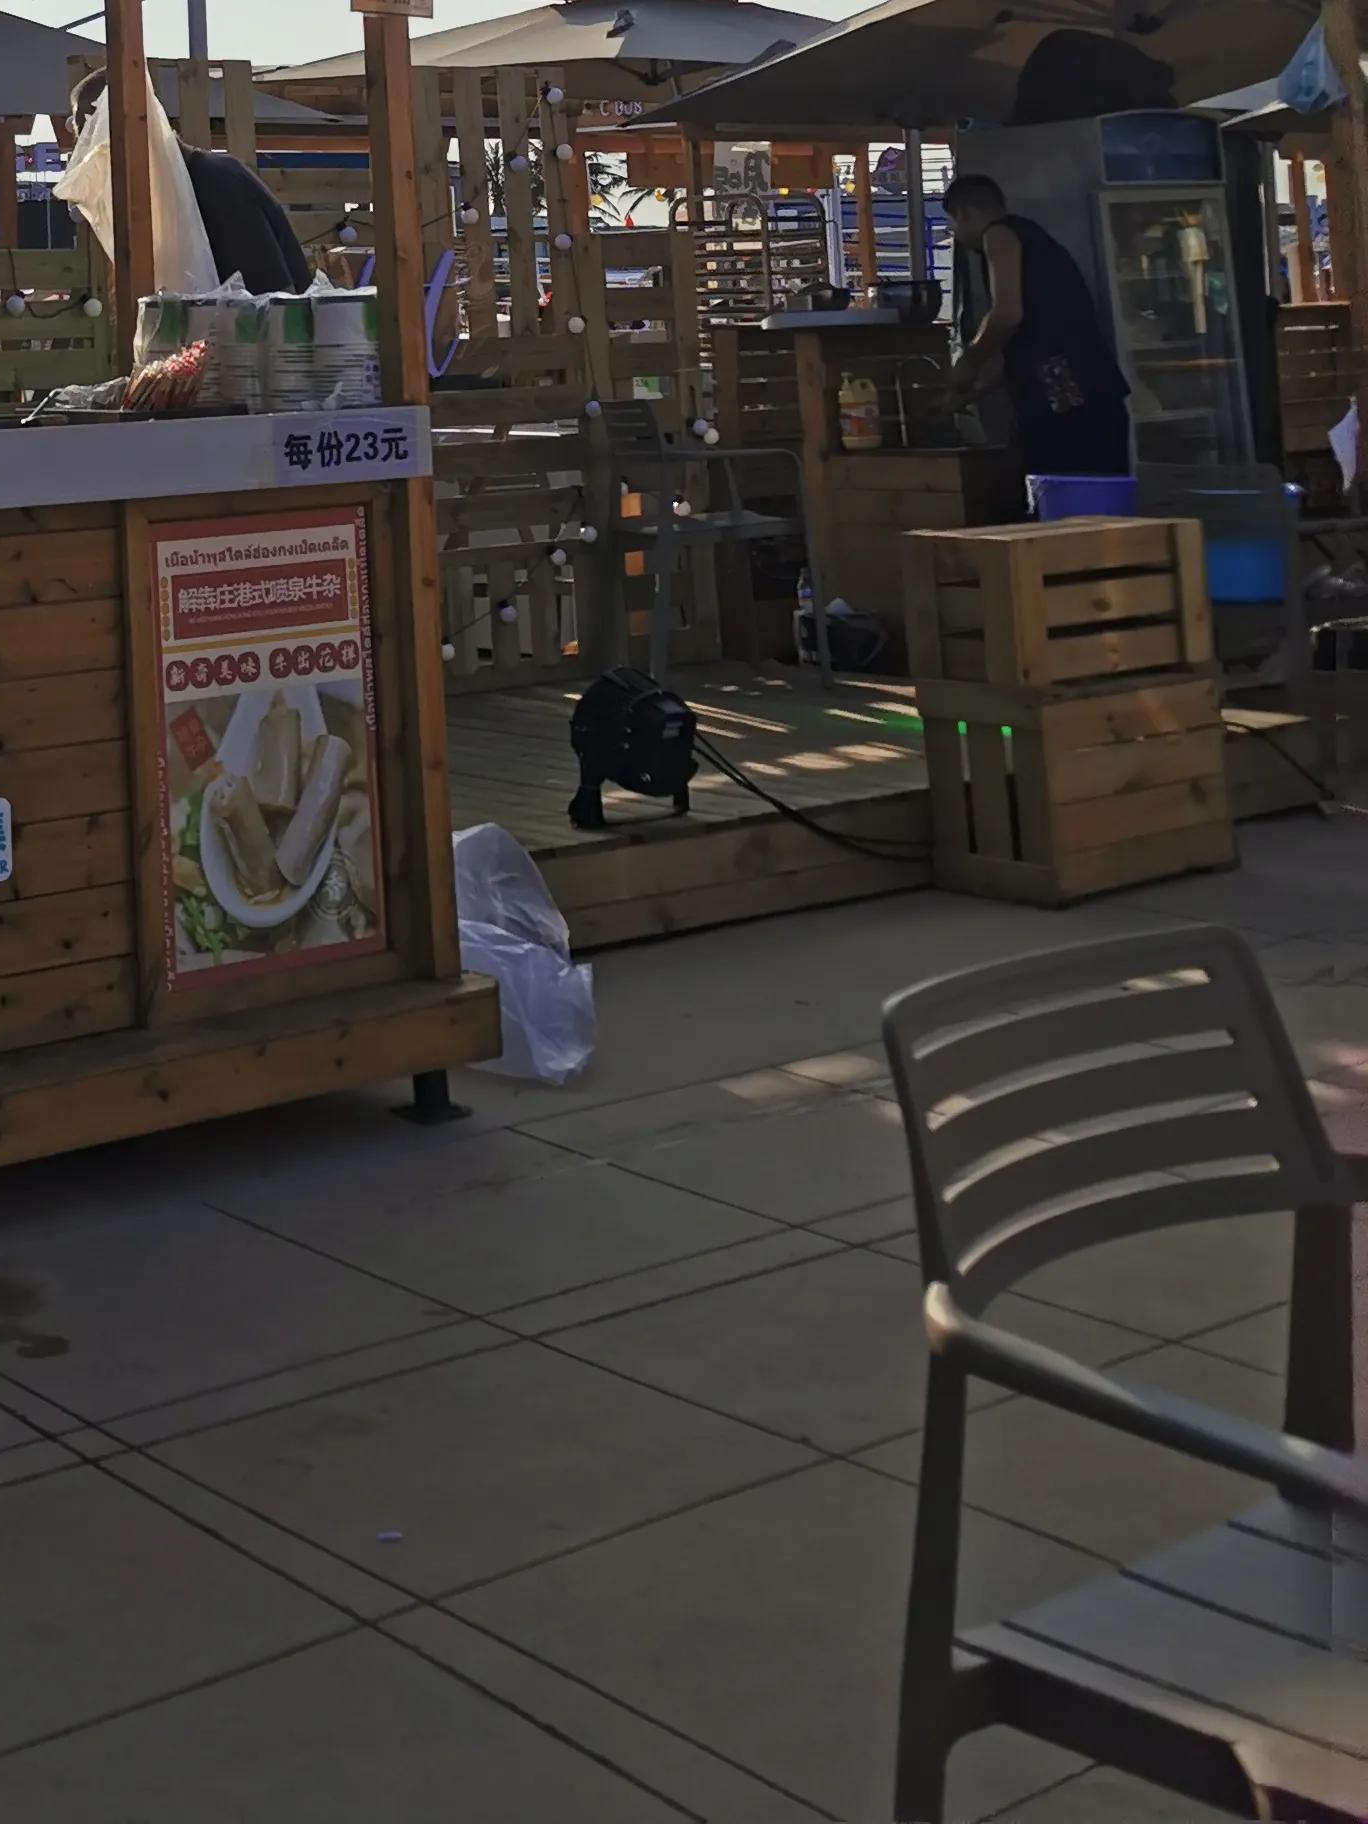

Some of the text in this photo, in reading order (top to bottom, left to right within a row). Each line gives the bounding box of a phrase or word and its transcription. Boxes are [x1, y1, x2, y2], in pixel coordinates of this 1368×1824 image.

[284, 427, 409, 470] 每份23元
[177, 573, 341, 614] 解犇庄港式喷泉牛杂
